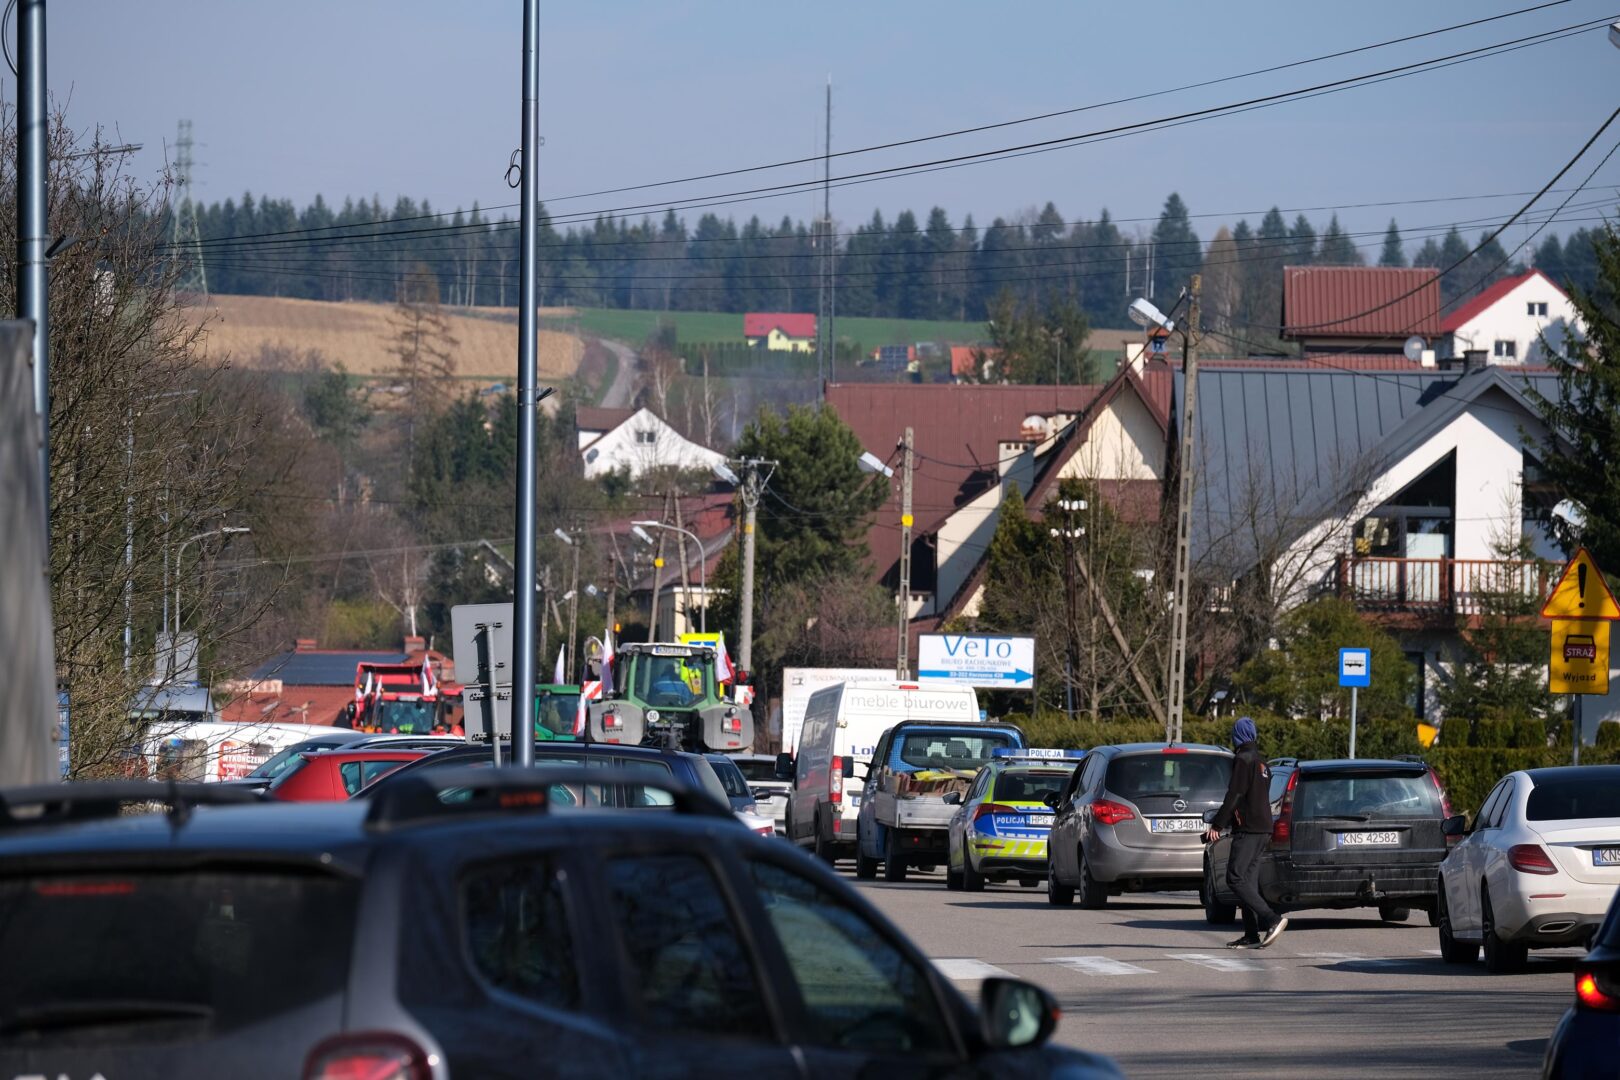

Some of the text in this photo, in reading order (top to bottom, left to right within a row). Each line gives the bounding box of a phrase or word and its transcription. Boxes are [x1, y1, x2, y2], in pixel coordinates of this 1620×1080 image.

[1566, 646, 1594, 657] STRAŻ
[1563, 672, 1596, 683] Wyjazd
[851, 695, 968, 710] meble biurowe
[1030, 750, 1062, 758] POLICJA
[996, 816, 1025, 824] POLICJA
[1032, 815, 1049, 824] HPG
[1157, 820, 1175, 830] KNS
[1343, 832, 1397, 844] KNS 42582
